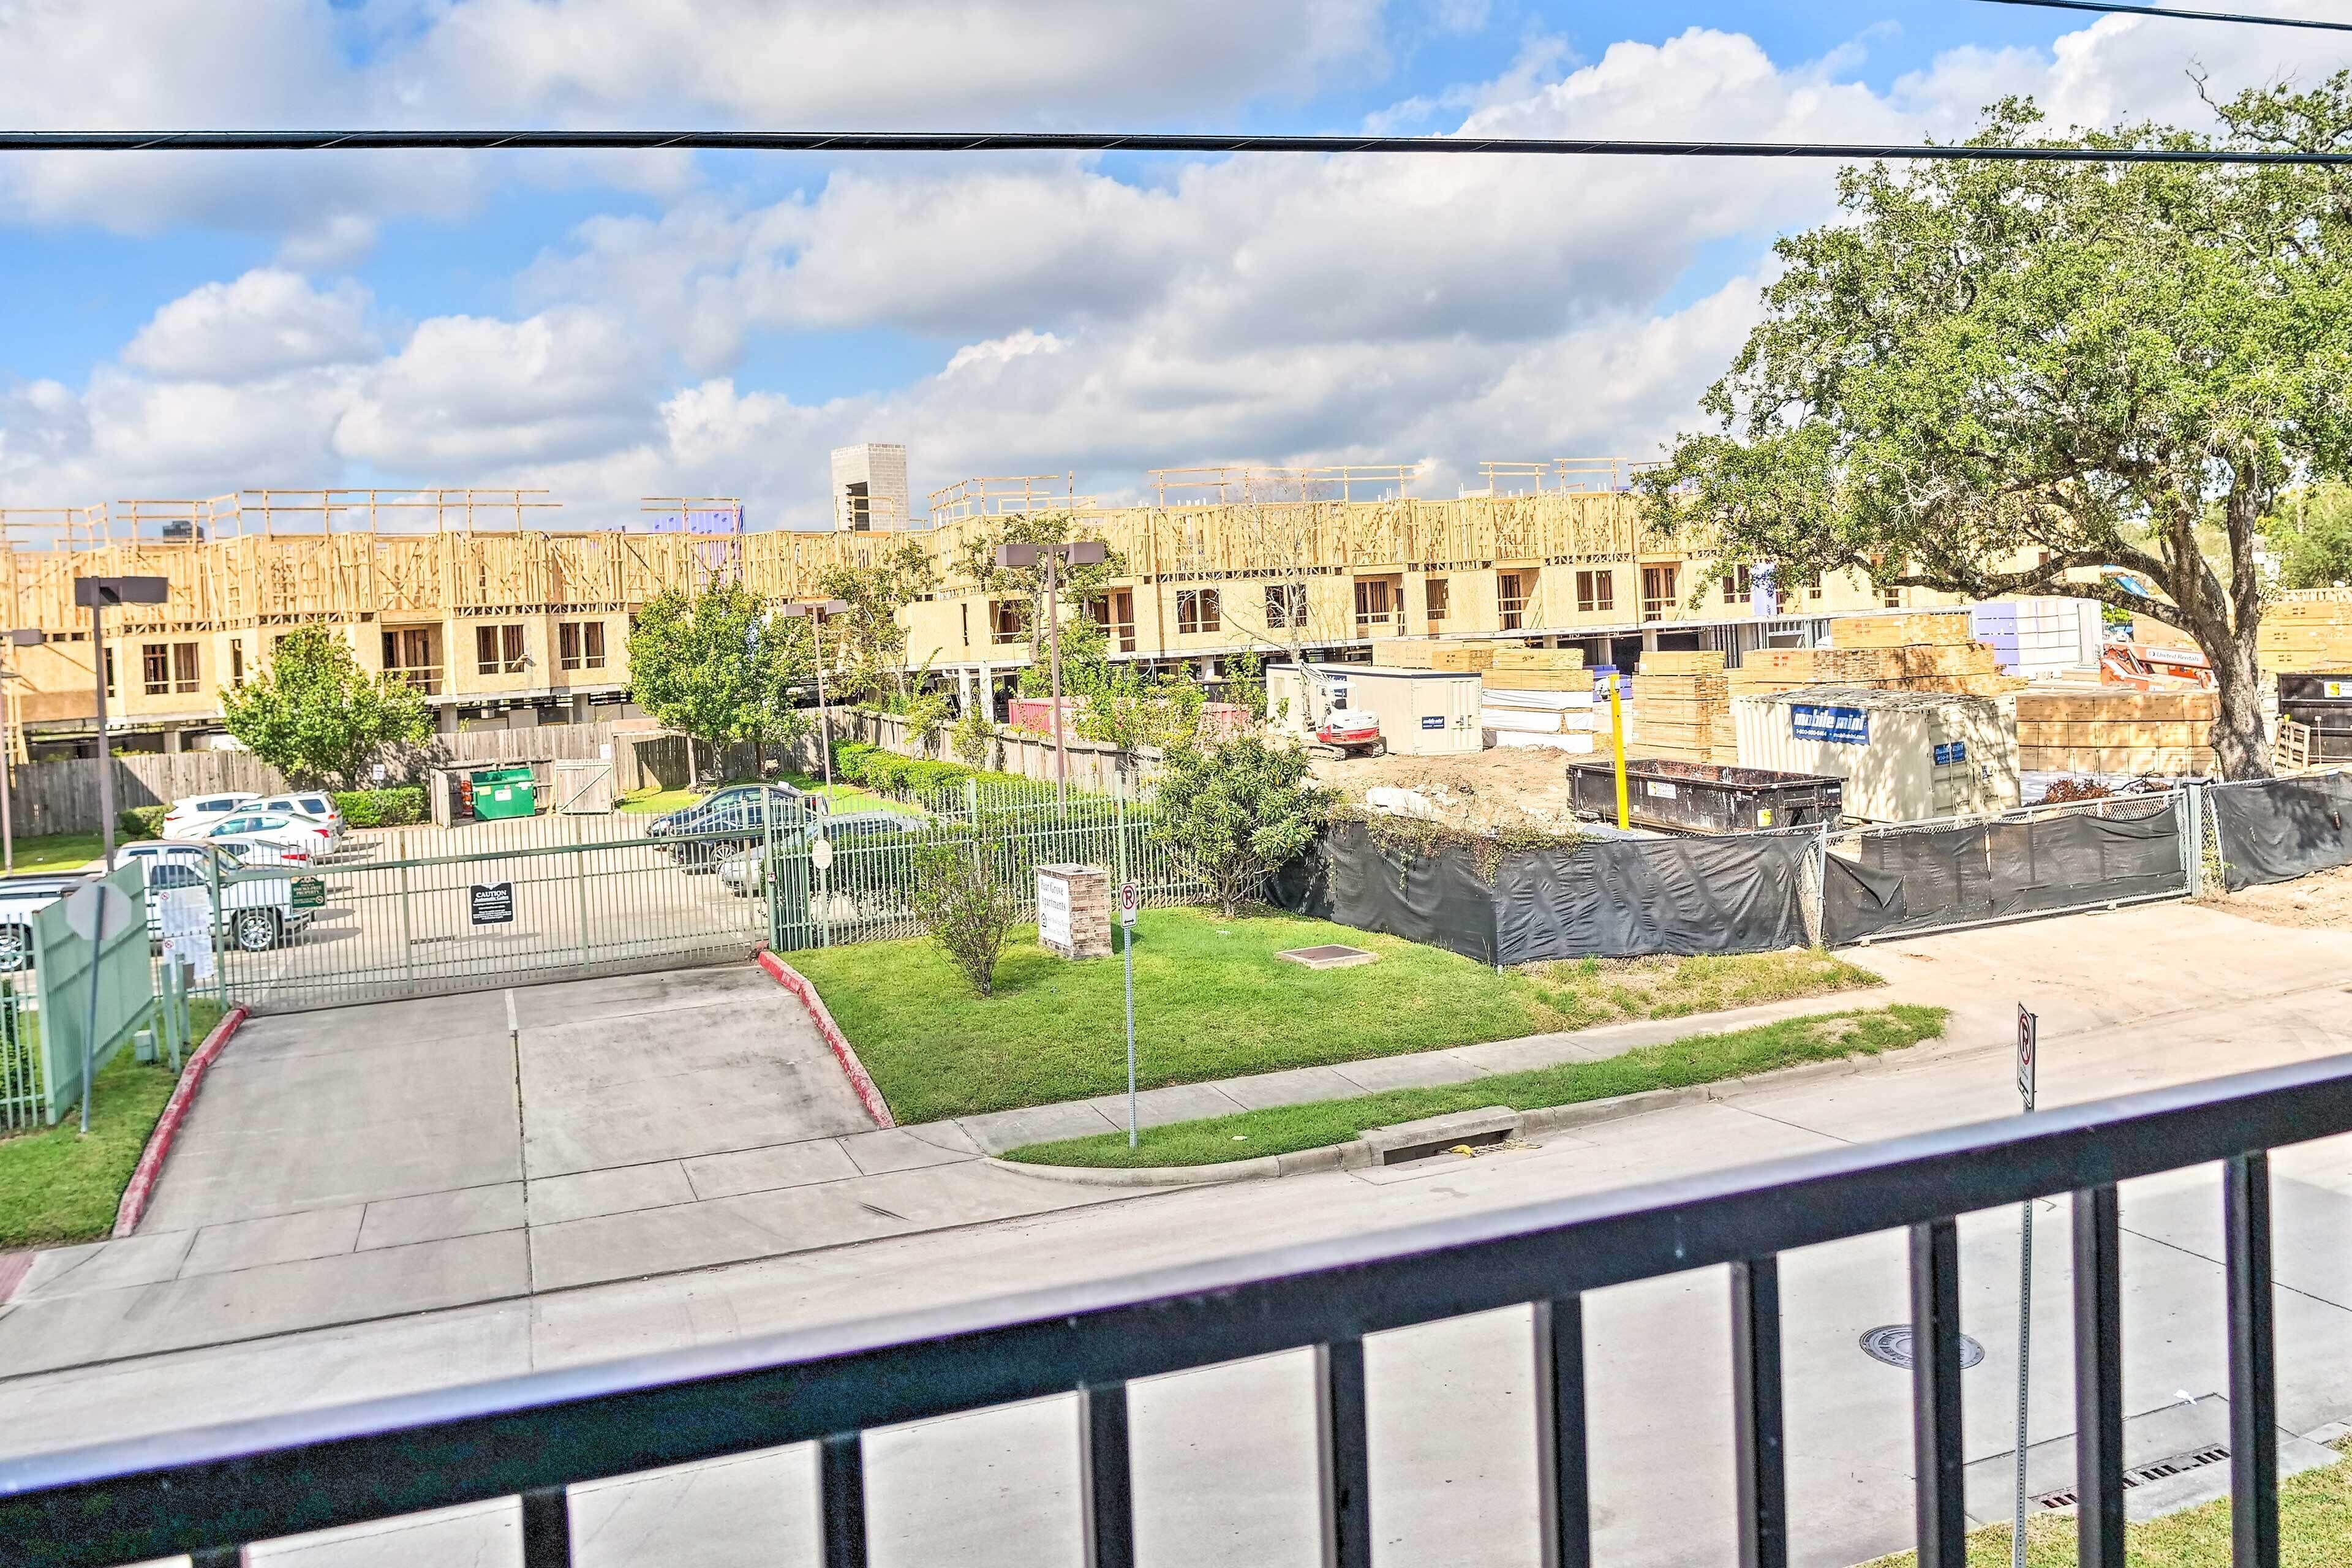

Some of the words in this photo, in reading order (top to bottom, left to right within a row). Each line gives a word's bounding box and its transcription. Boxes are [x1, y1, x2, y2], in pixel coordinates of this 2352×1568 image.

[1793, 709, 1836, 729] mobile
[1835, 714, 1867, 731] mini
[1050, 881, 1064, 896] Grove
[1042, 895, 1066, 912] Apartments
